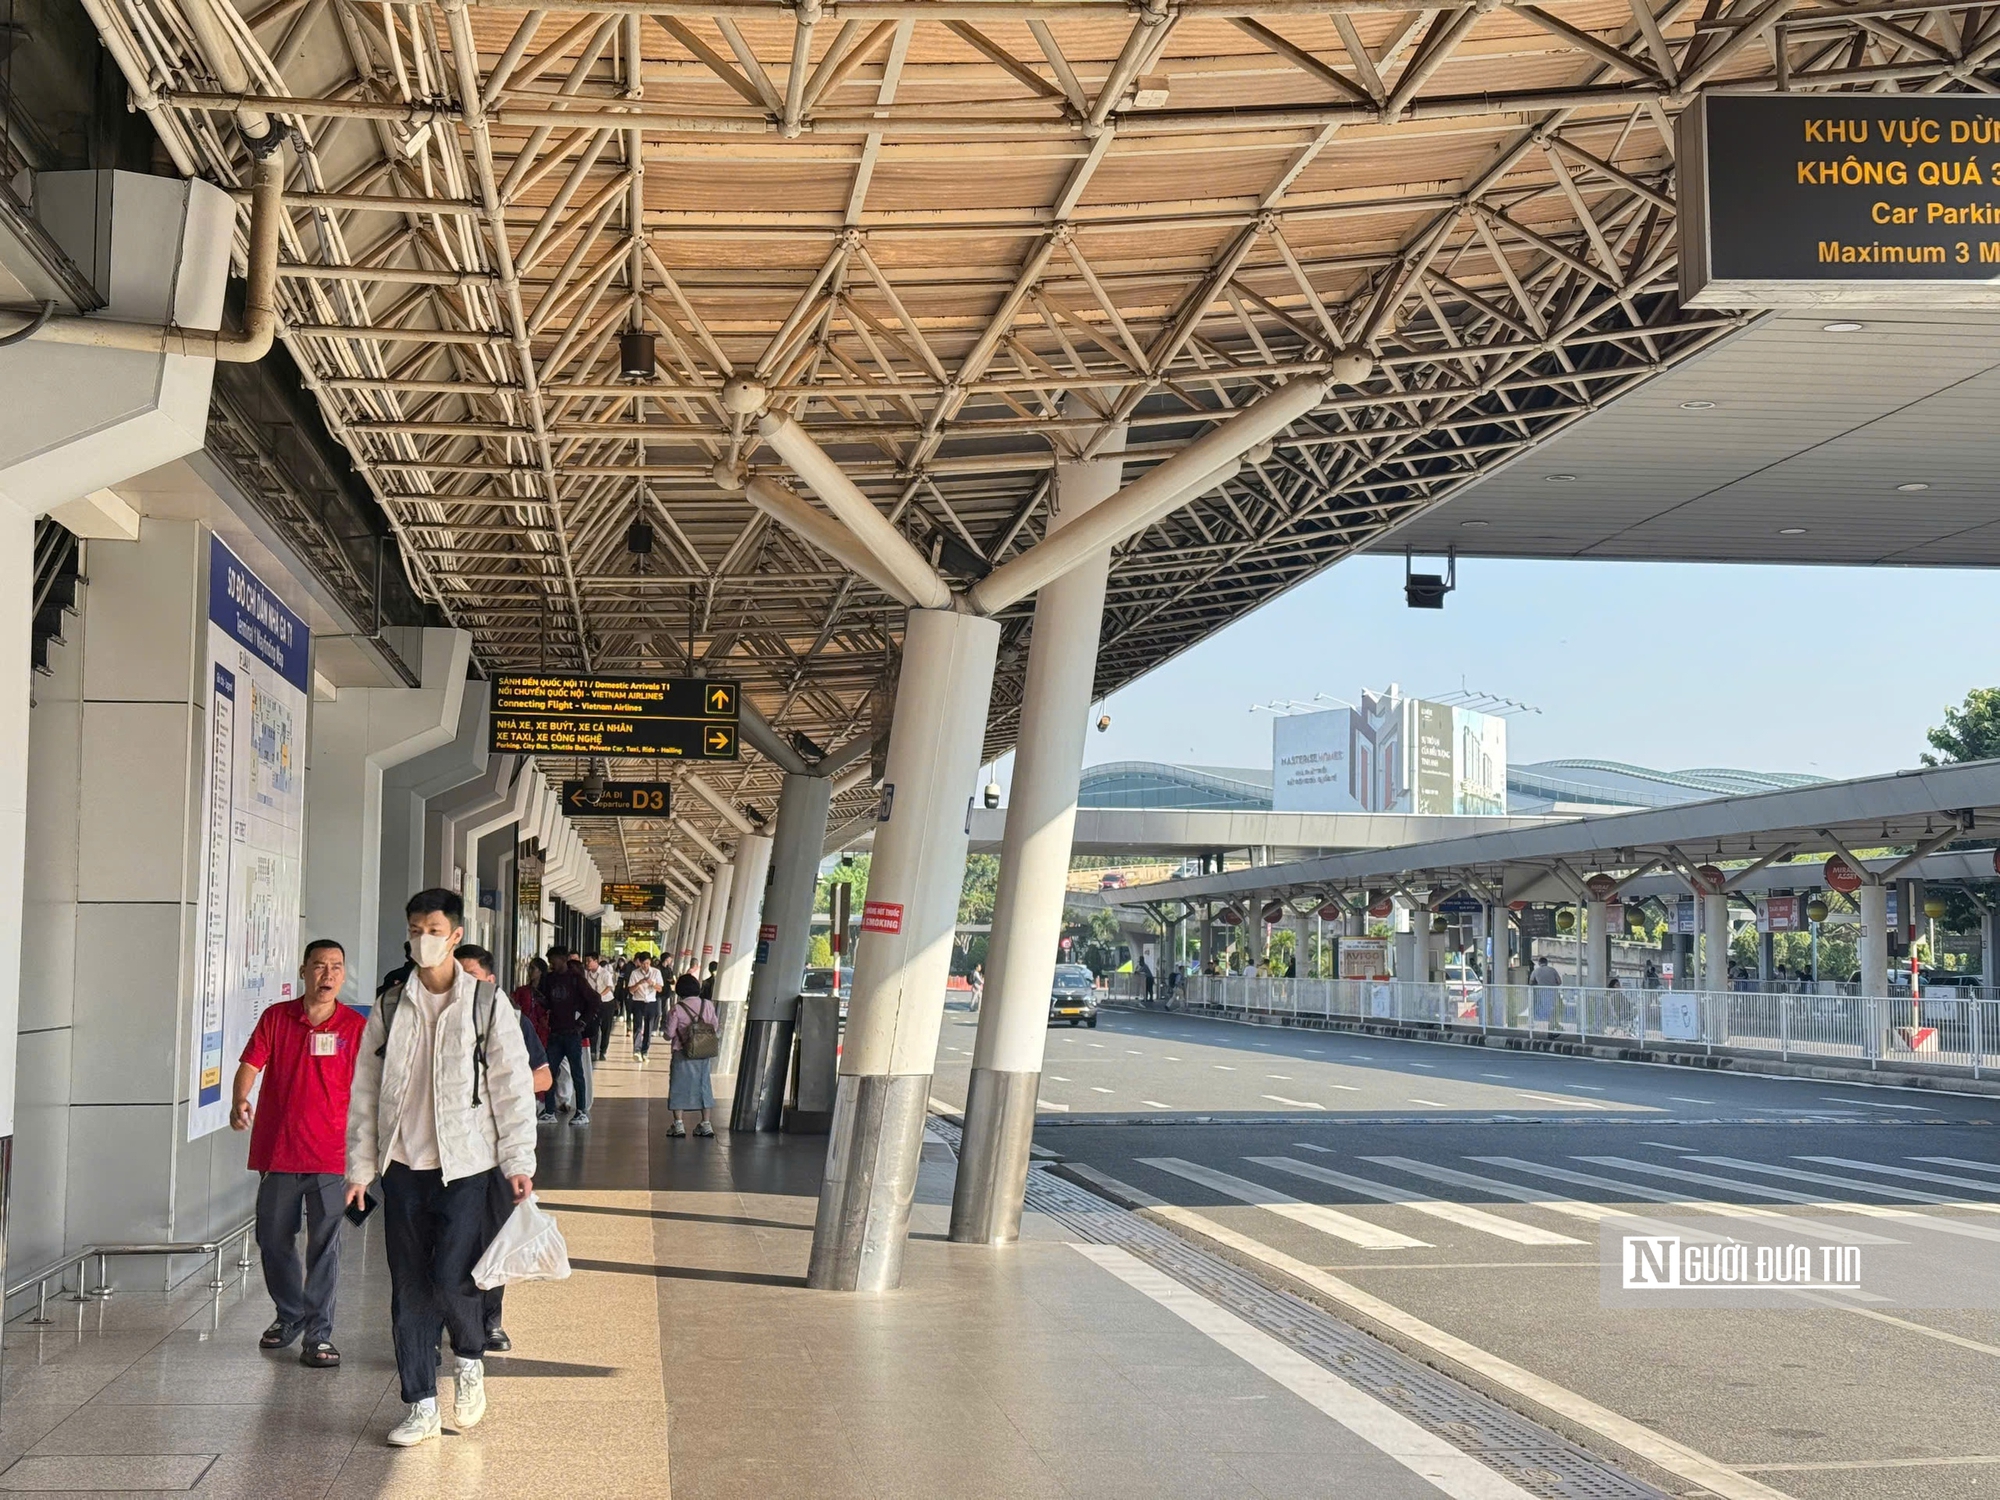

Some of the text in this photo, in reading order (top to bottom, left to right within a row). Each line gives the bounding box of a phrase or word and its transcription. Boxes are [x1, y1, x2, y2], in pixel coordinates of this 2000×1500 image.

[1804, 119, 1868, 143] KHU
[1877, 117, 1941, 148] VỰC
[1797, 155, 1908, 185] KHÔNG
[1918, 156, 1983, 186] QUÁ
[1871, 202, 2000, 225] Car Parki
[1818, 241, 1946, 264] Maximum
[1955, 242, 1970, 264] 3
[236, 611, 254, 645] Terminal
[498, 676, 521, 686] SẢNH
[522, 676, 538, 686] ĐẾN
[540, 677, 562, 688] QUỐC
[563, 679, 578, 689] NỘI
[595, 680, 628, 690] Domestic
[630, 682, 660, 690] Arrivals
[661, 683, 670, 691] T1
[498, 686, 512, 695] NỐI
[547, 688, 568, 698] QUỐC
[570, 688, 584, 699] NỘI
[591, 690, 626, 700] VIETNAM
[628, 692, 664, 700] AIRLINES
[498, 698, 546, 710] Connecting
[548, 700, 574, 711] Flight
[582, 702, 612, 710] Vietnam
[614, 704, 642, 712] Airlines
[496, 719, 633, 733] NHÀ XE, XE BUÝT, XE CÁ NHÂN
[496, 732, 602, 745] XE TAXI, XE CÔNG NGHỆ
[632, 790, 664, 810] D3
[866, 918, 898, 929] SMOKING
